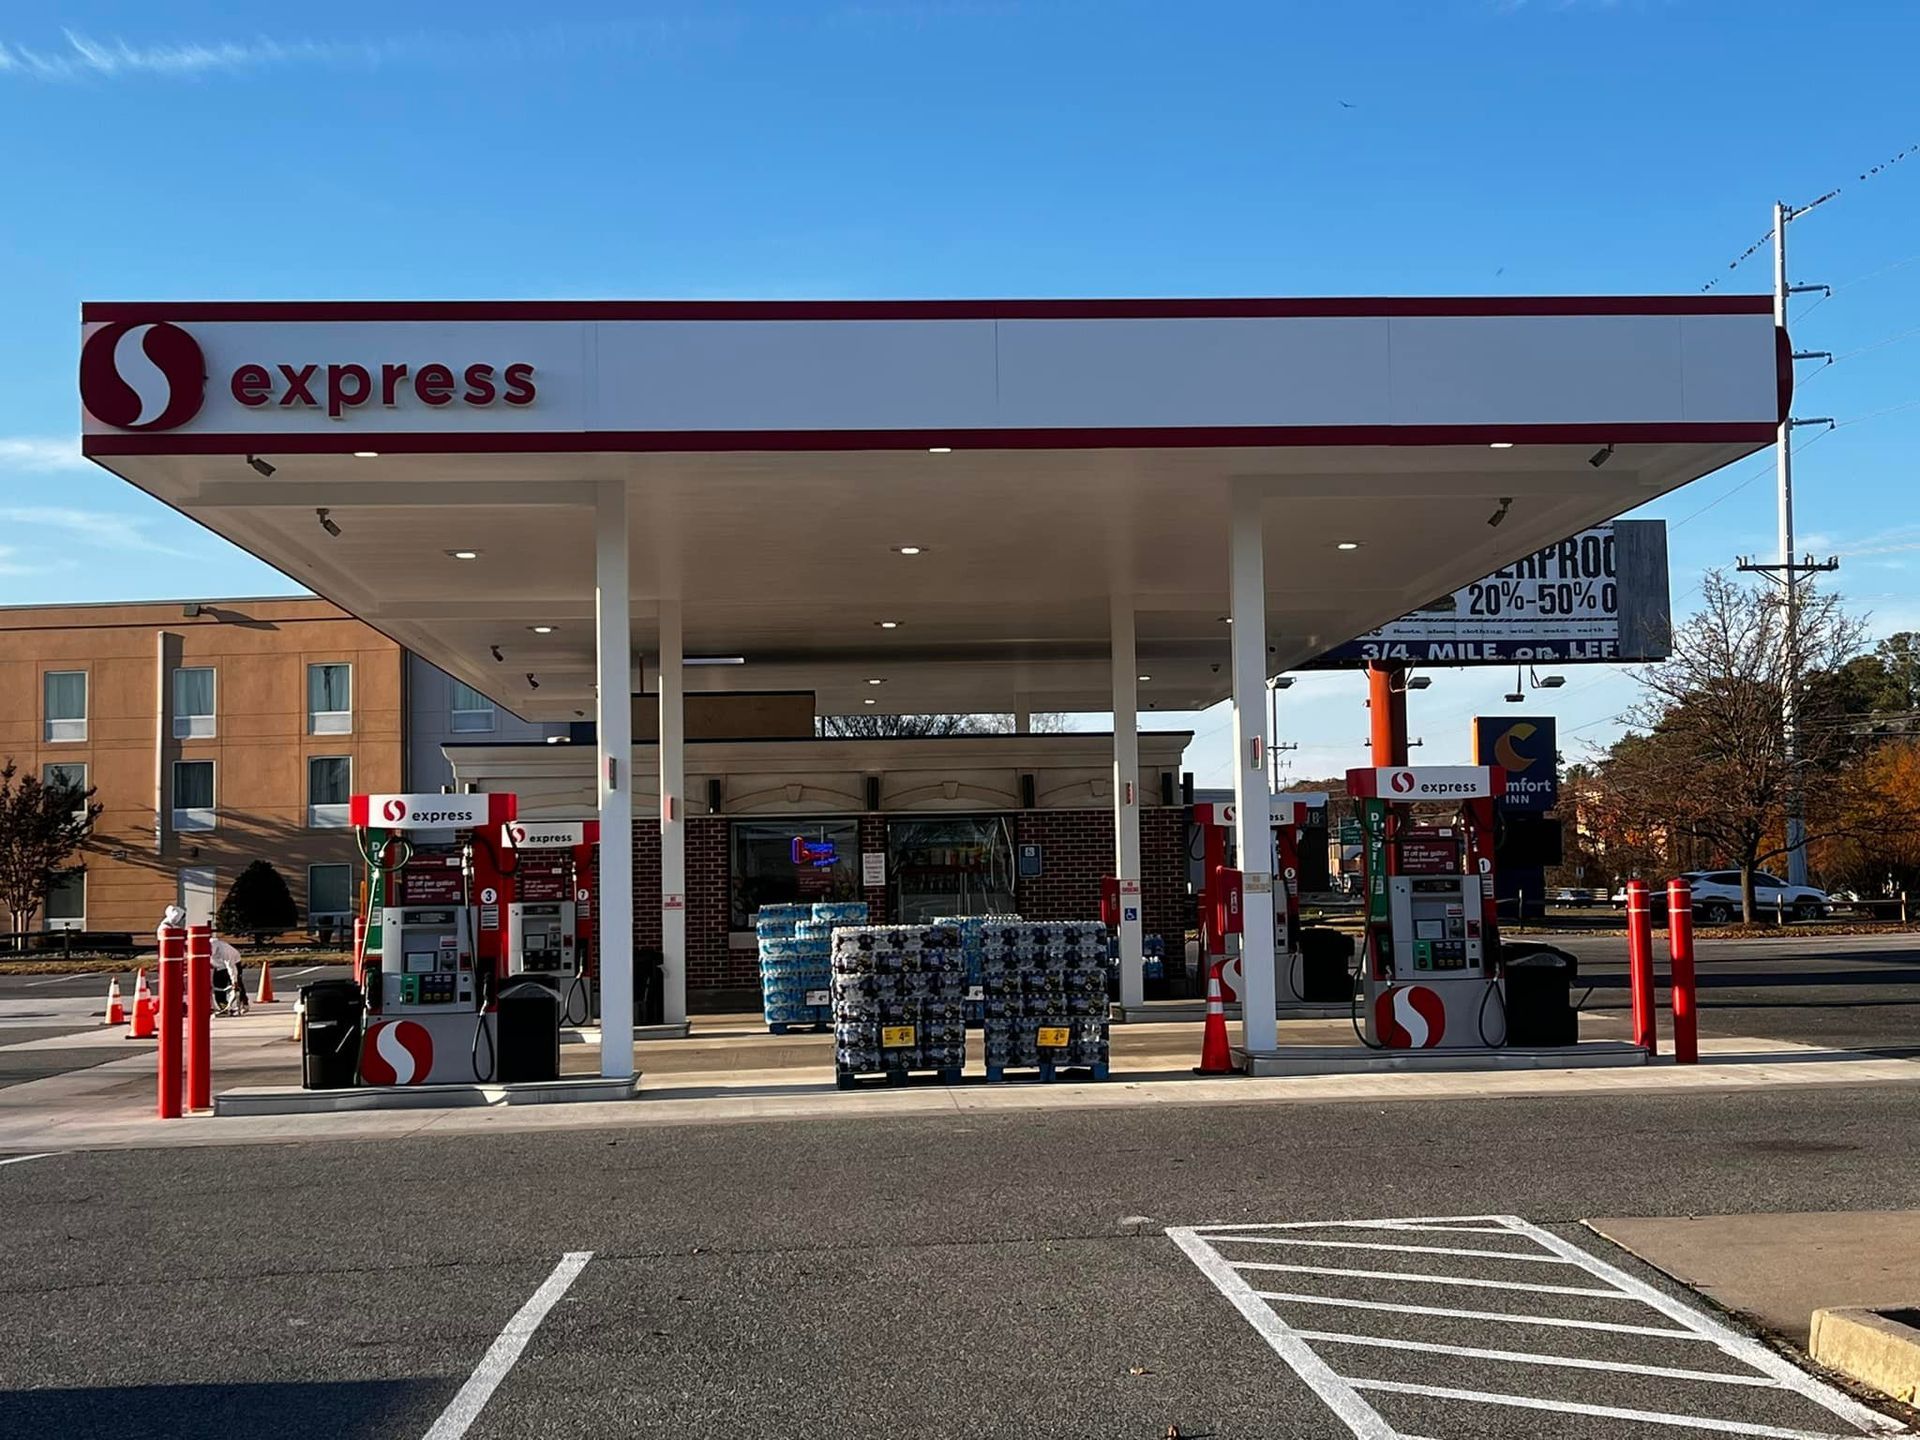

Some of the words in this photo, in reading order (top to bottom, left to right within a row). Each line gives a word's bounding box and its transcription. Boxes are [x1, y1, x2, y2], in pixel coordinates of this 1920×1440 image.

[231, 363, 536, 418] express
[1469, 581, 1597, 616] 20%-50%
[1362, 642, 1409, 660] 3/4
[1428, 642, 1497, 660] MILE
[1569, 641, 1618, 659] LEF
[1420, 782, 1477, 795] express
[1505, 777, 1552, 792] mfort
[1506, 794, 1529, 804] INN
[412, 809, 473, 823] express
[529, 833, 573, 843] express
[485, 890, 492, 902] 3
[580, 890, 586, 899] 7
